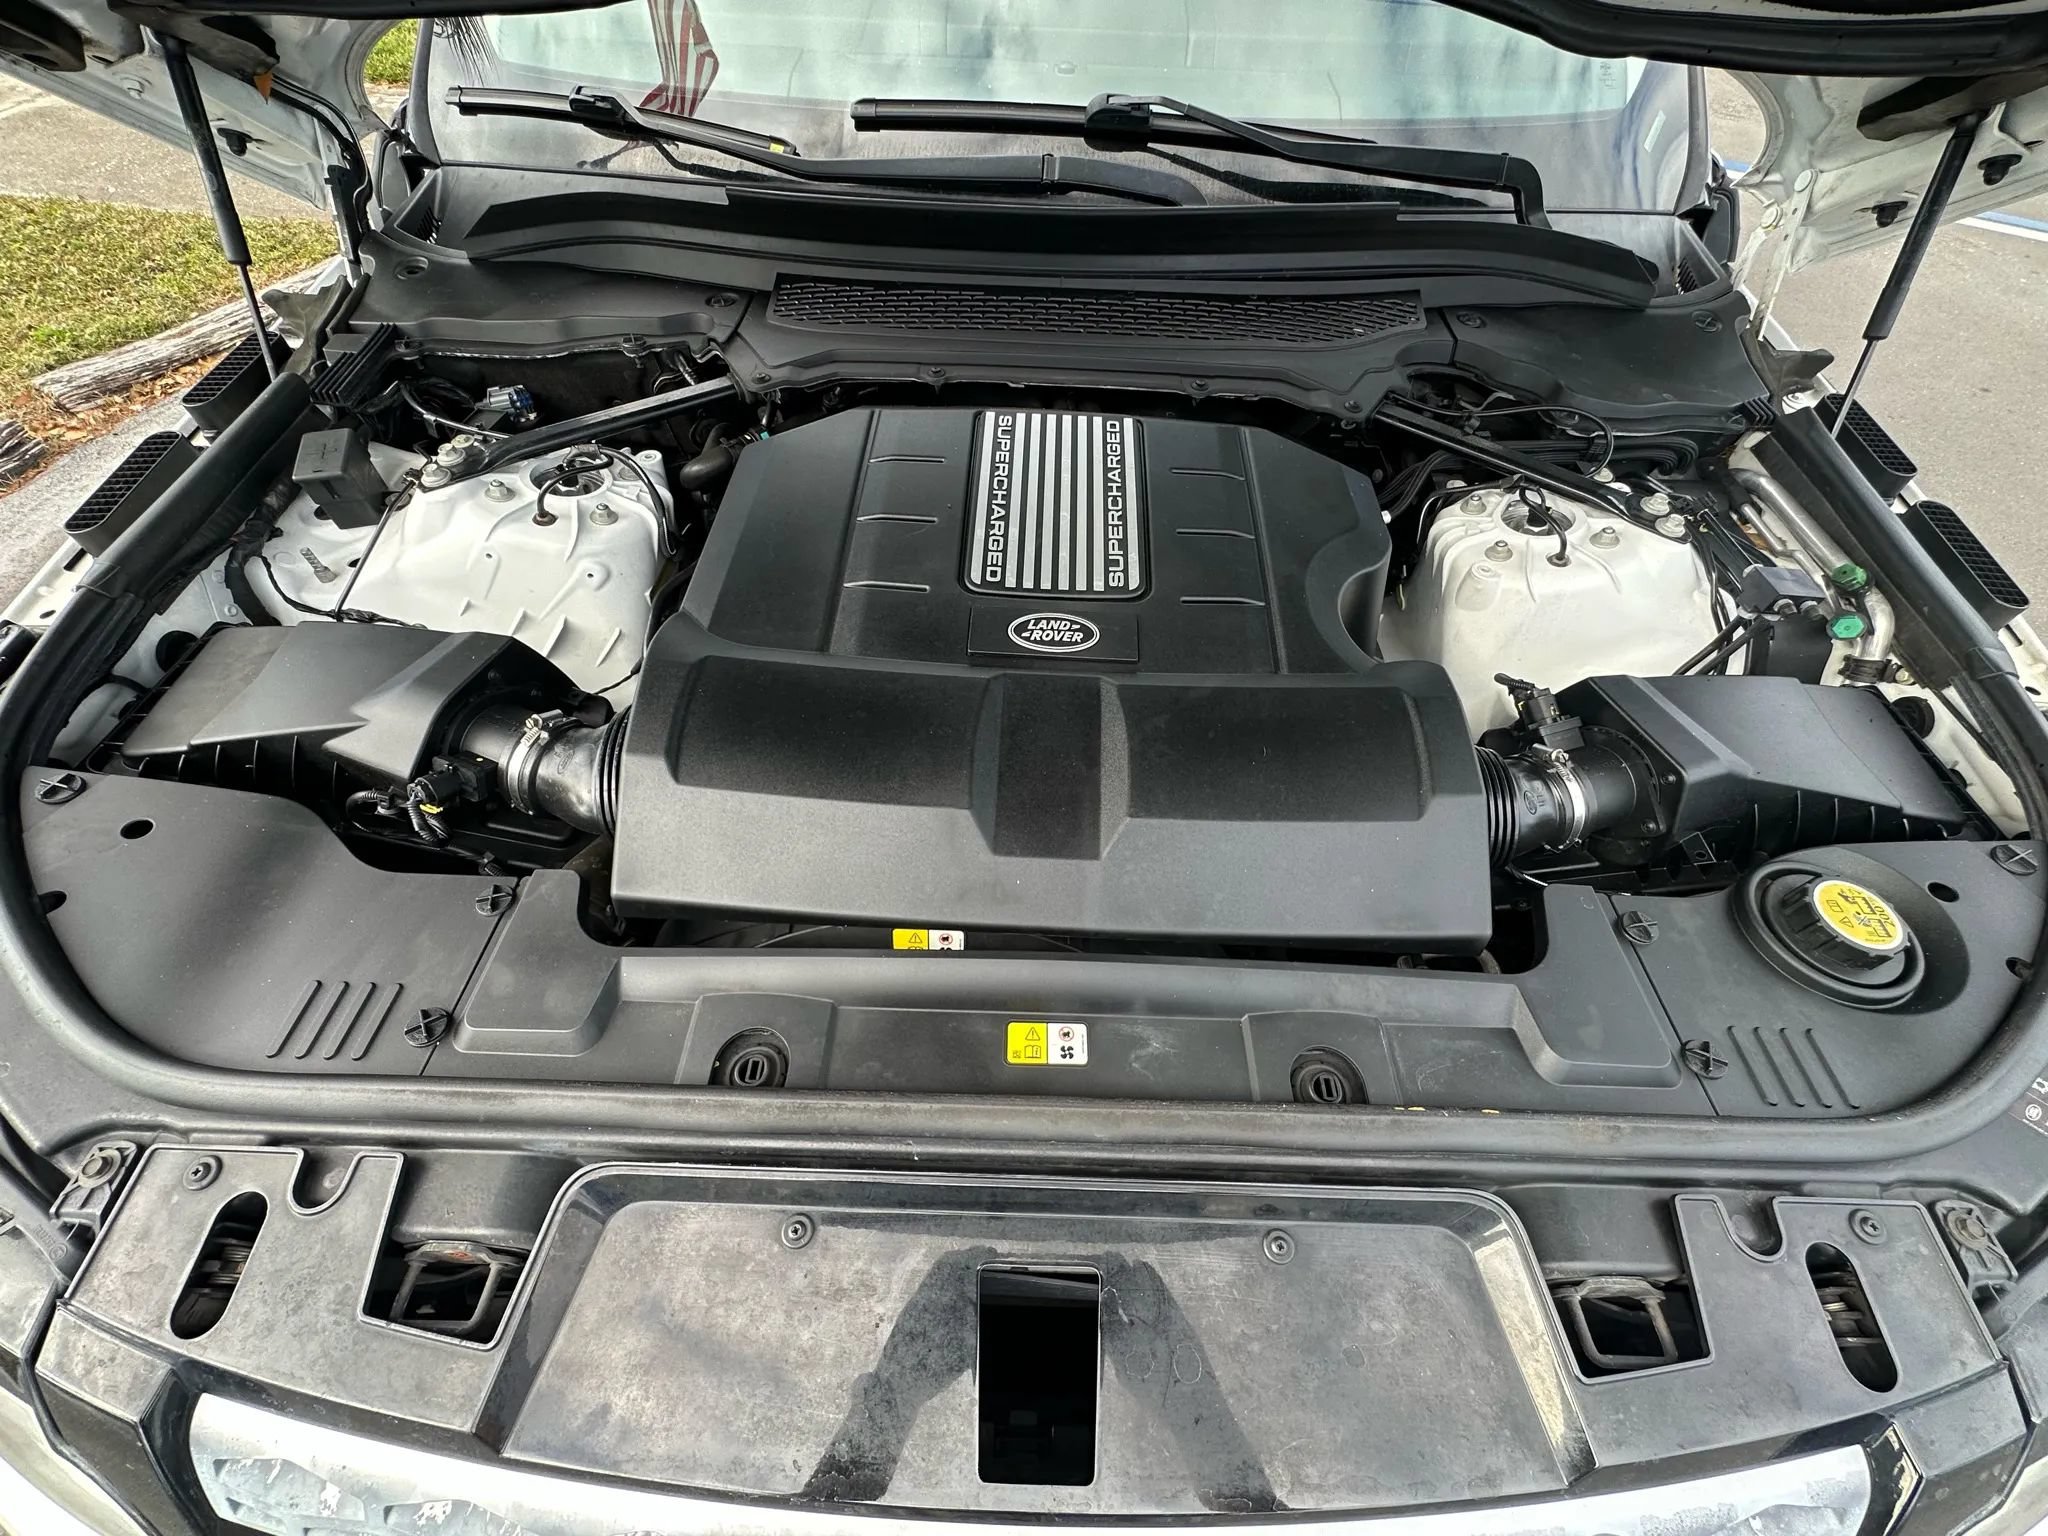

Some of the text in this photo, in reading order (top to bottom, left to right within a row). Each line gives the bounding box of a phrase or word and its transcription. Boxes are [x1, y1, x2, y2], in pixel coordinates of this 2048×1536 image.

[985, 415, 1012, 582] SUPERCHARGED
[1106, 420, 1125, 587] SUPERCHARGED
[1027, 619, 1071, 630] LAND
[1029, 629, 1084, 643] ROVER
